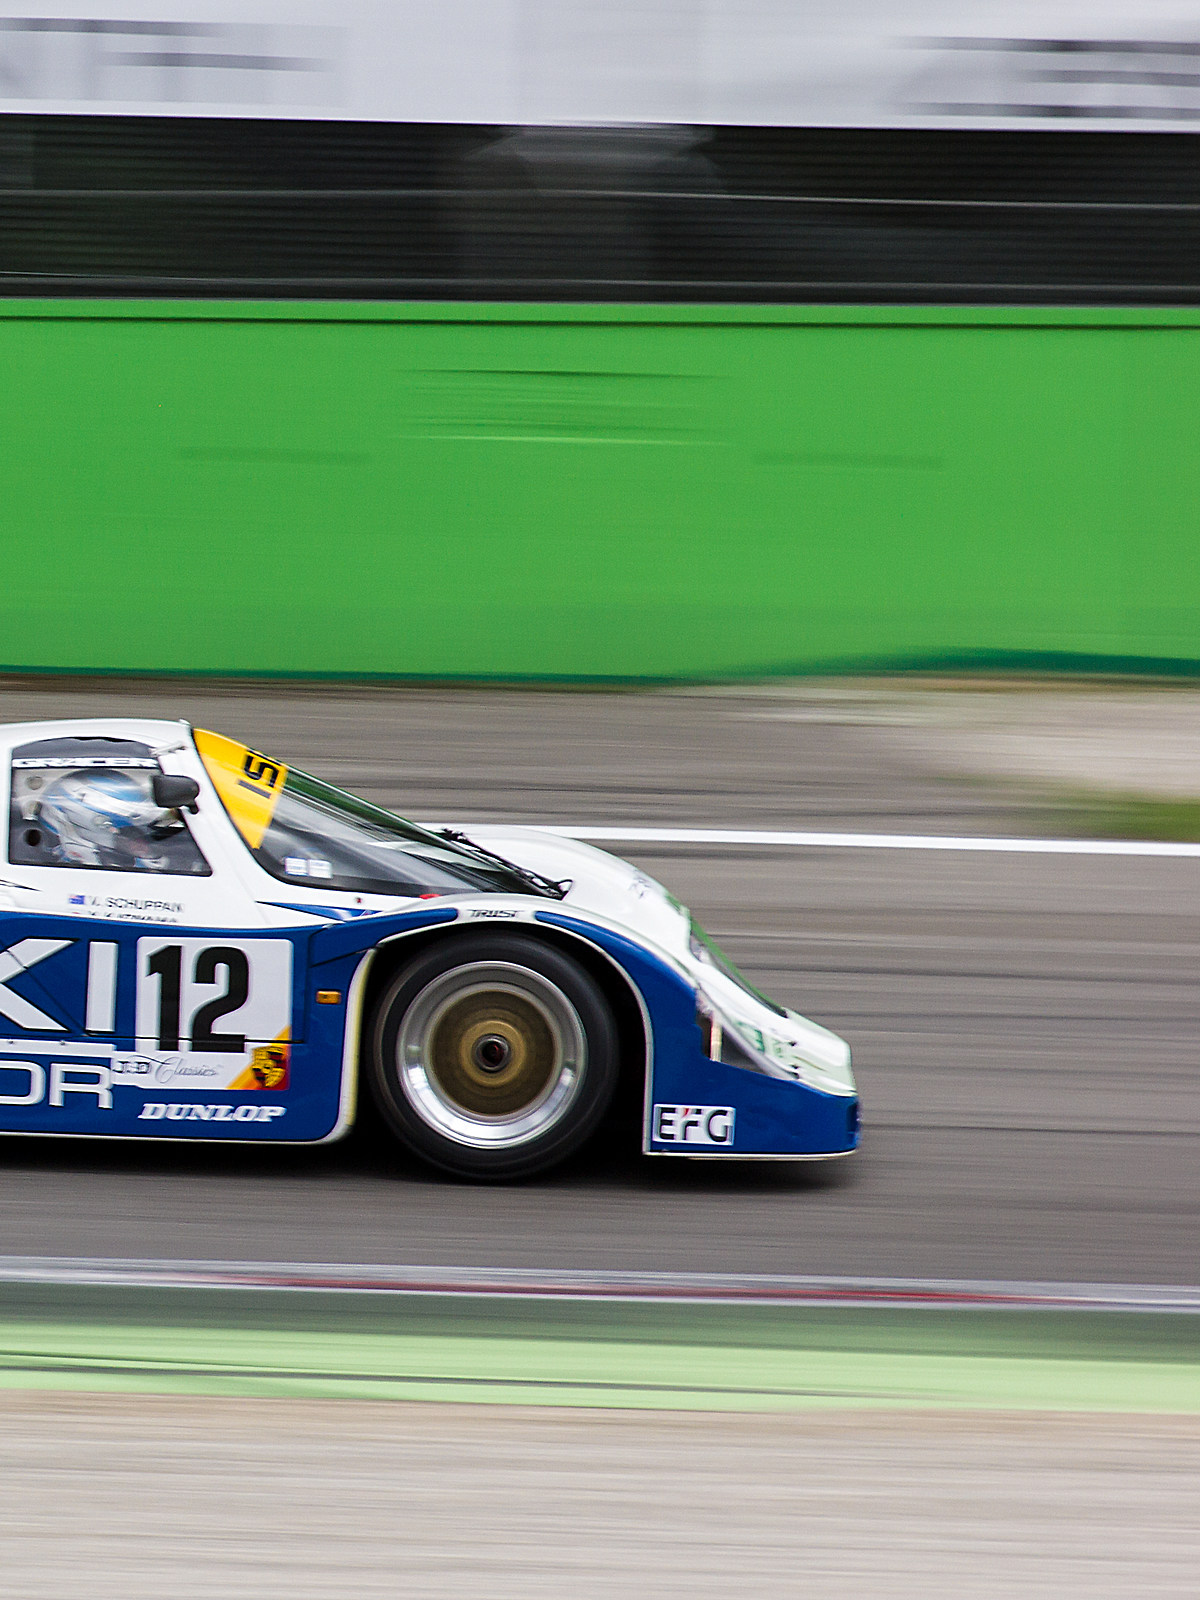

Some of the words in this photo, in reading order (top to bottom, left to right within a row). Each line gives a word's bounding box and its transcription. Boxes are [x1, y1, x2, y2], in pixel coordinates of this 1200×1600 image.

[145, 944, 250, 1053] 12
[137, 1103, 287, 1123] DUNLOP
[659, 1107, 734, 1143] EFG
